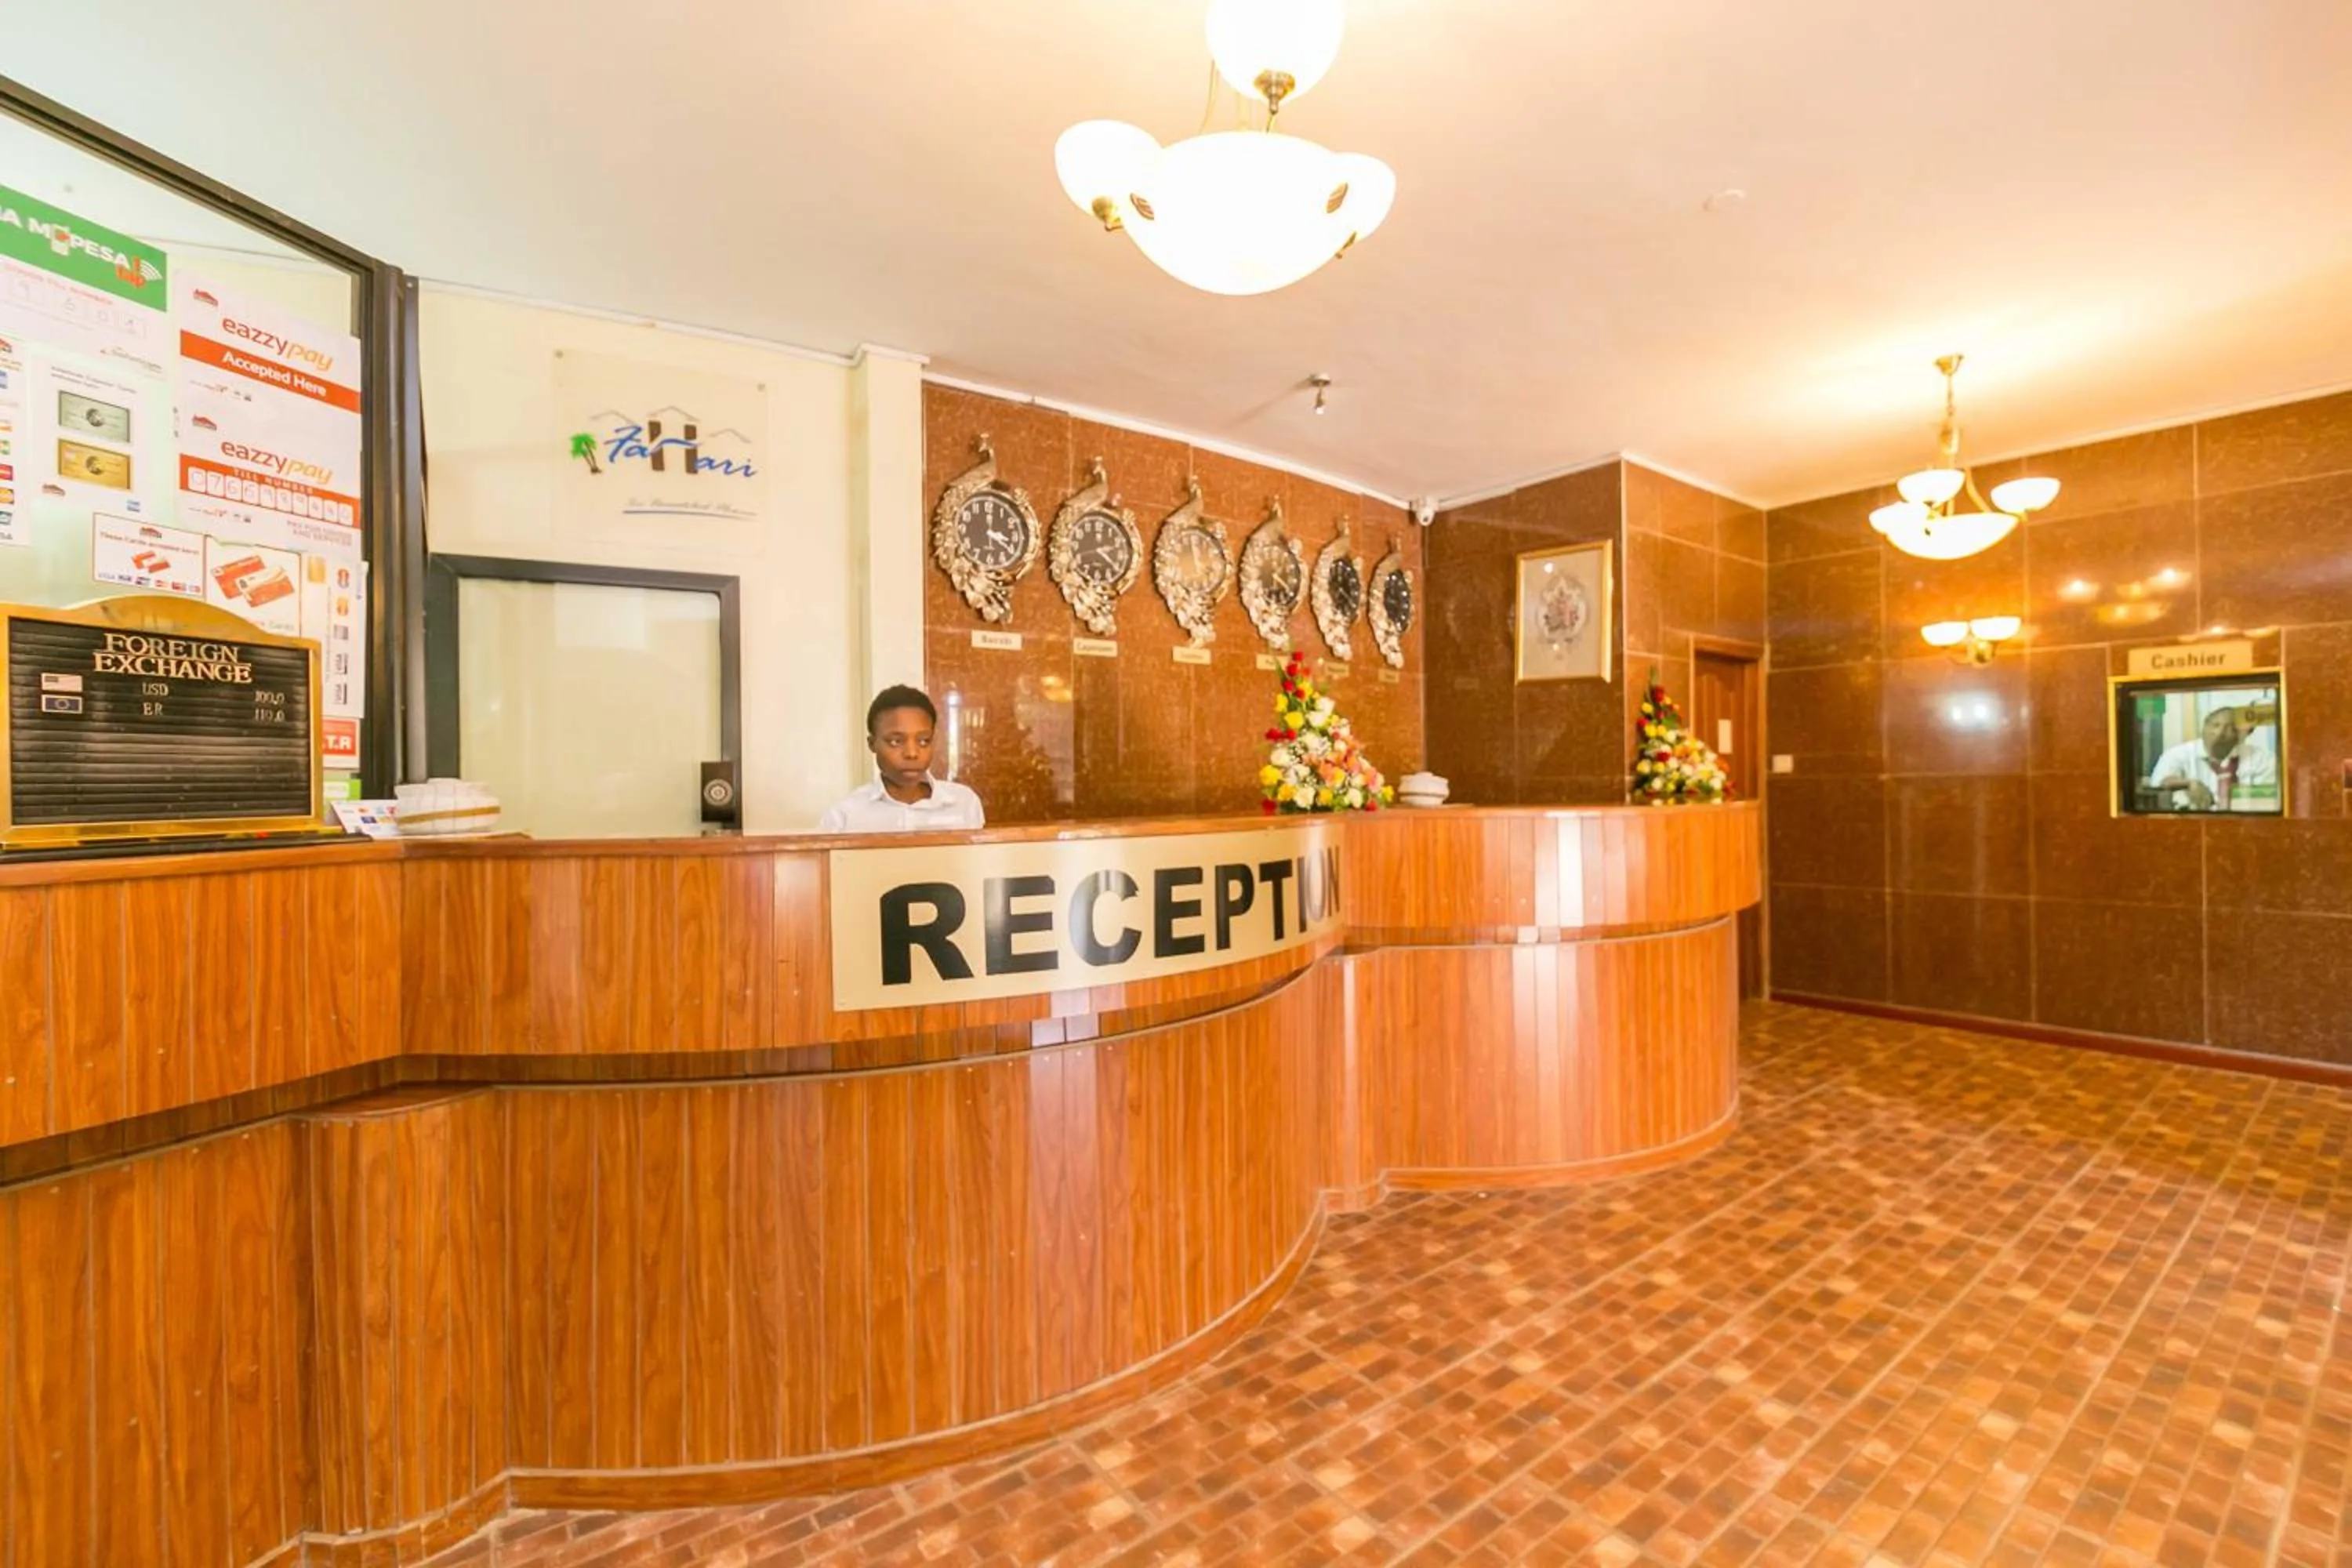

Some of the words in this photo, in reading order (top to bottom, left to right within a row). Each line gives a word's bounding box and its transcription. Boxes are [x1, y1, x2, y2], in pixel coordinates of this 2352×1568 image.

[222, 351, 291, 384] Accepted
[293, 374, 327, 397] Here
[103, 633, 239, 663] FOREIGN
[2151, 652, 2226, 670] Cashier
[93, 651, 252, 684] EXCHANGE
[142, 682, 169, 696] USD
[880, 845, 1340, 985] RECEPTION
